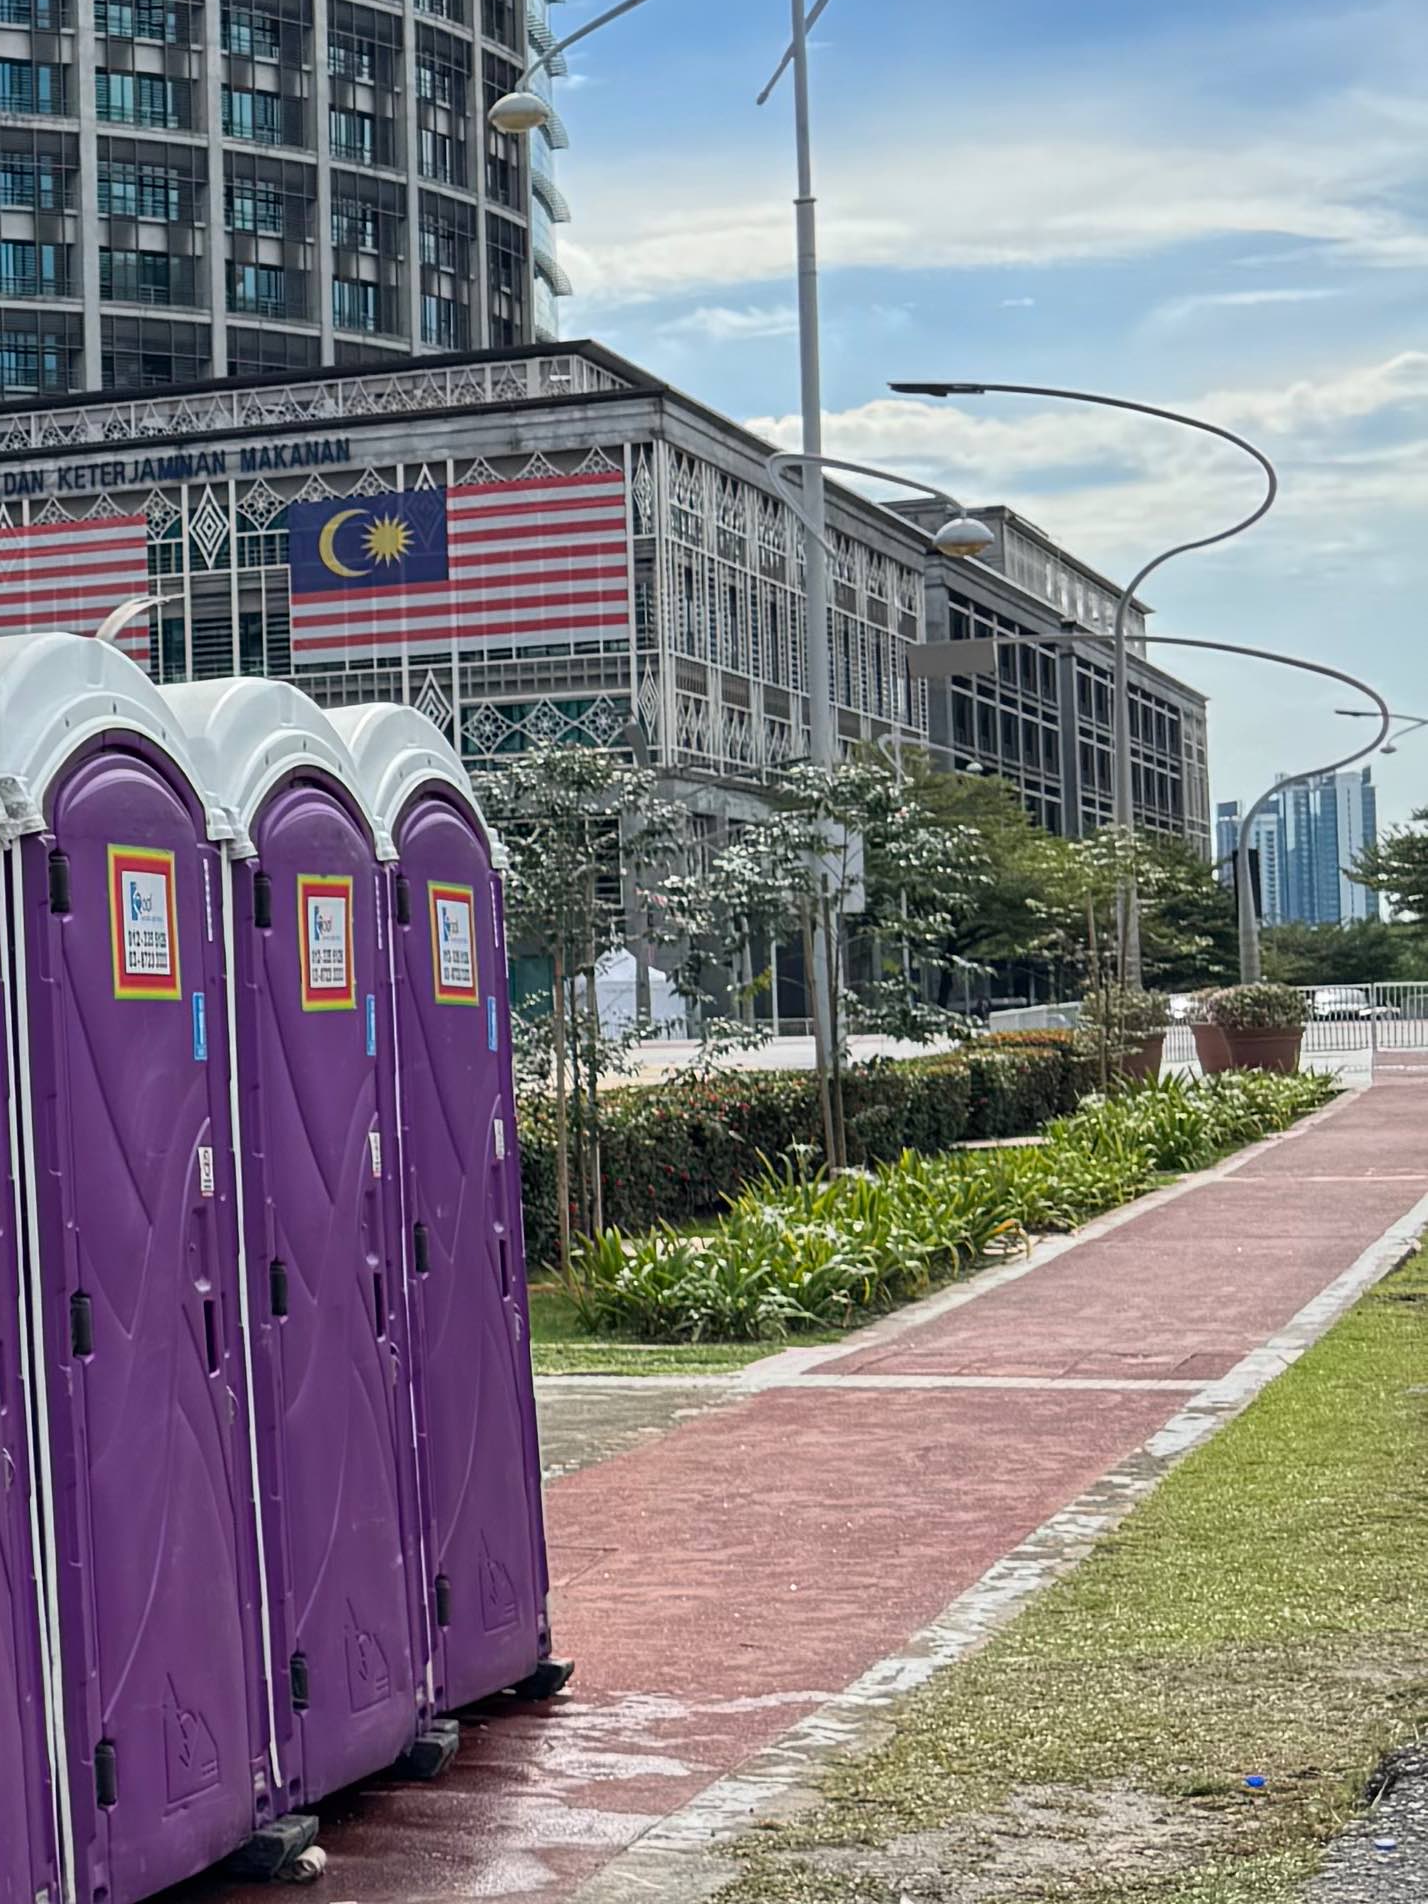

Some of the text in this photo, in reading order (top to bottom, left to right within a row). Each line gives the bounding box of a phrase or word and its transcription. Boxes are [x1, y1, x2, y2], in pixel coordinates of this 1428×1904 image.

[3, 470, 44, 495] DAN
[57, 450, 227, 491] KETERJAMINAN
[240, 438, 351, 472] MAKANAN
